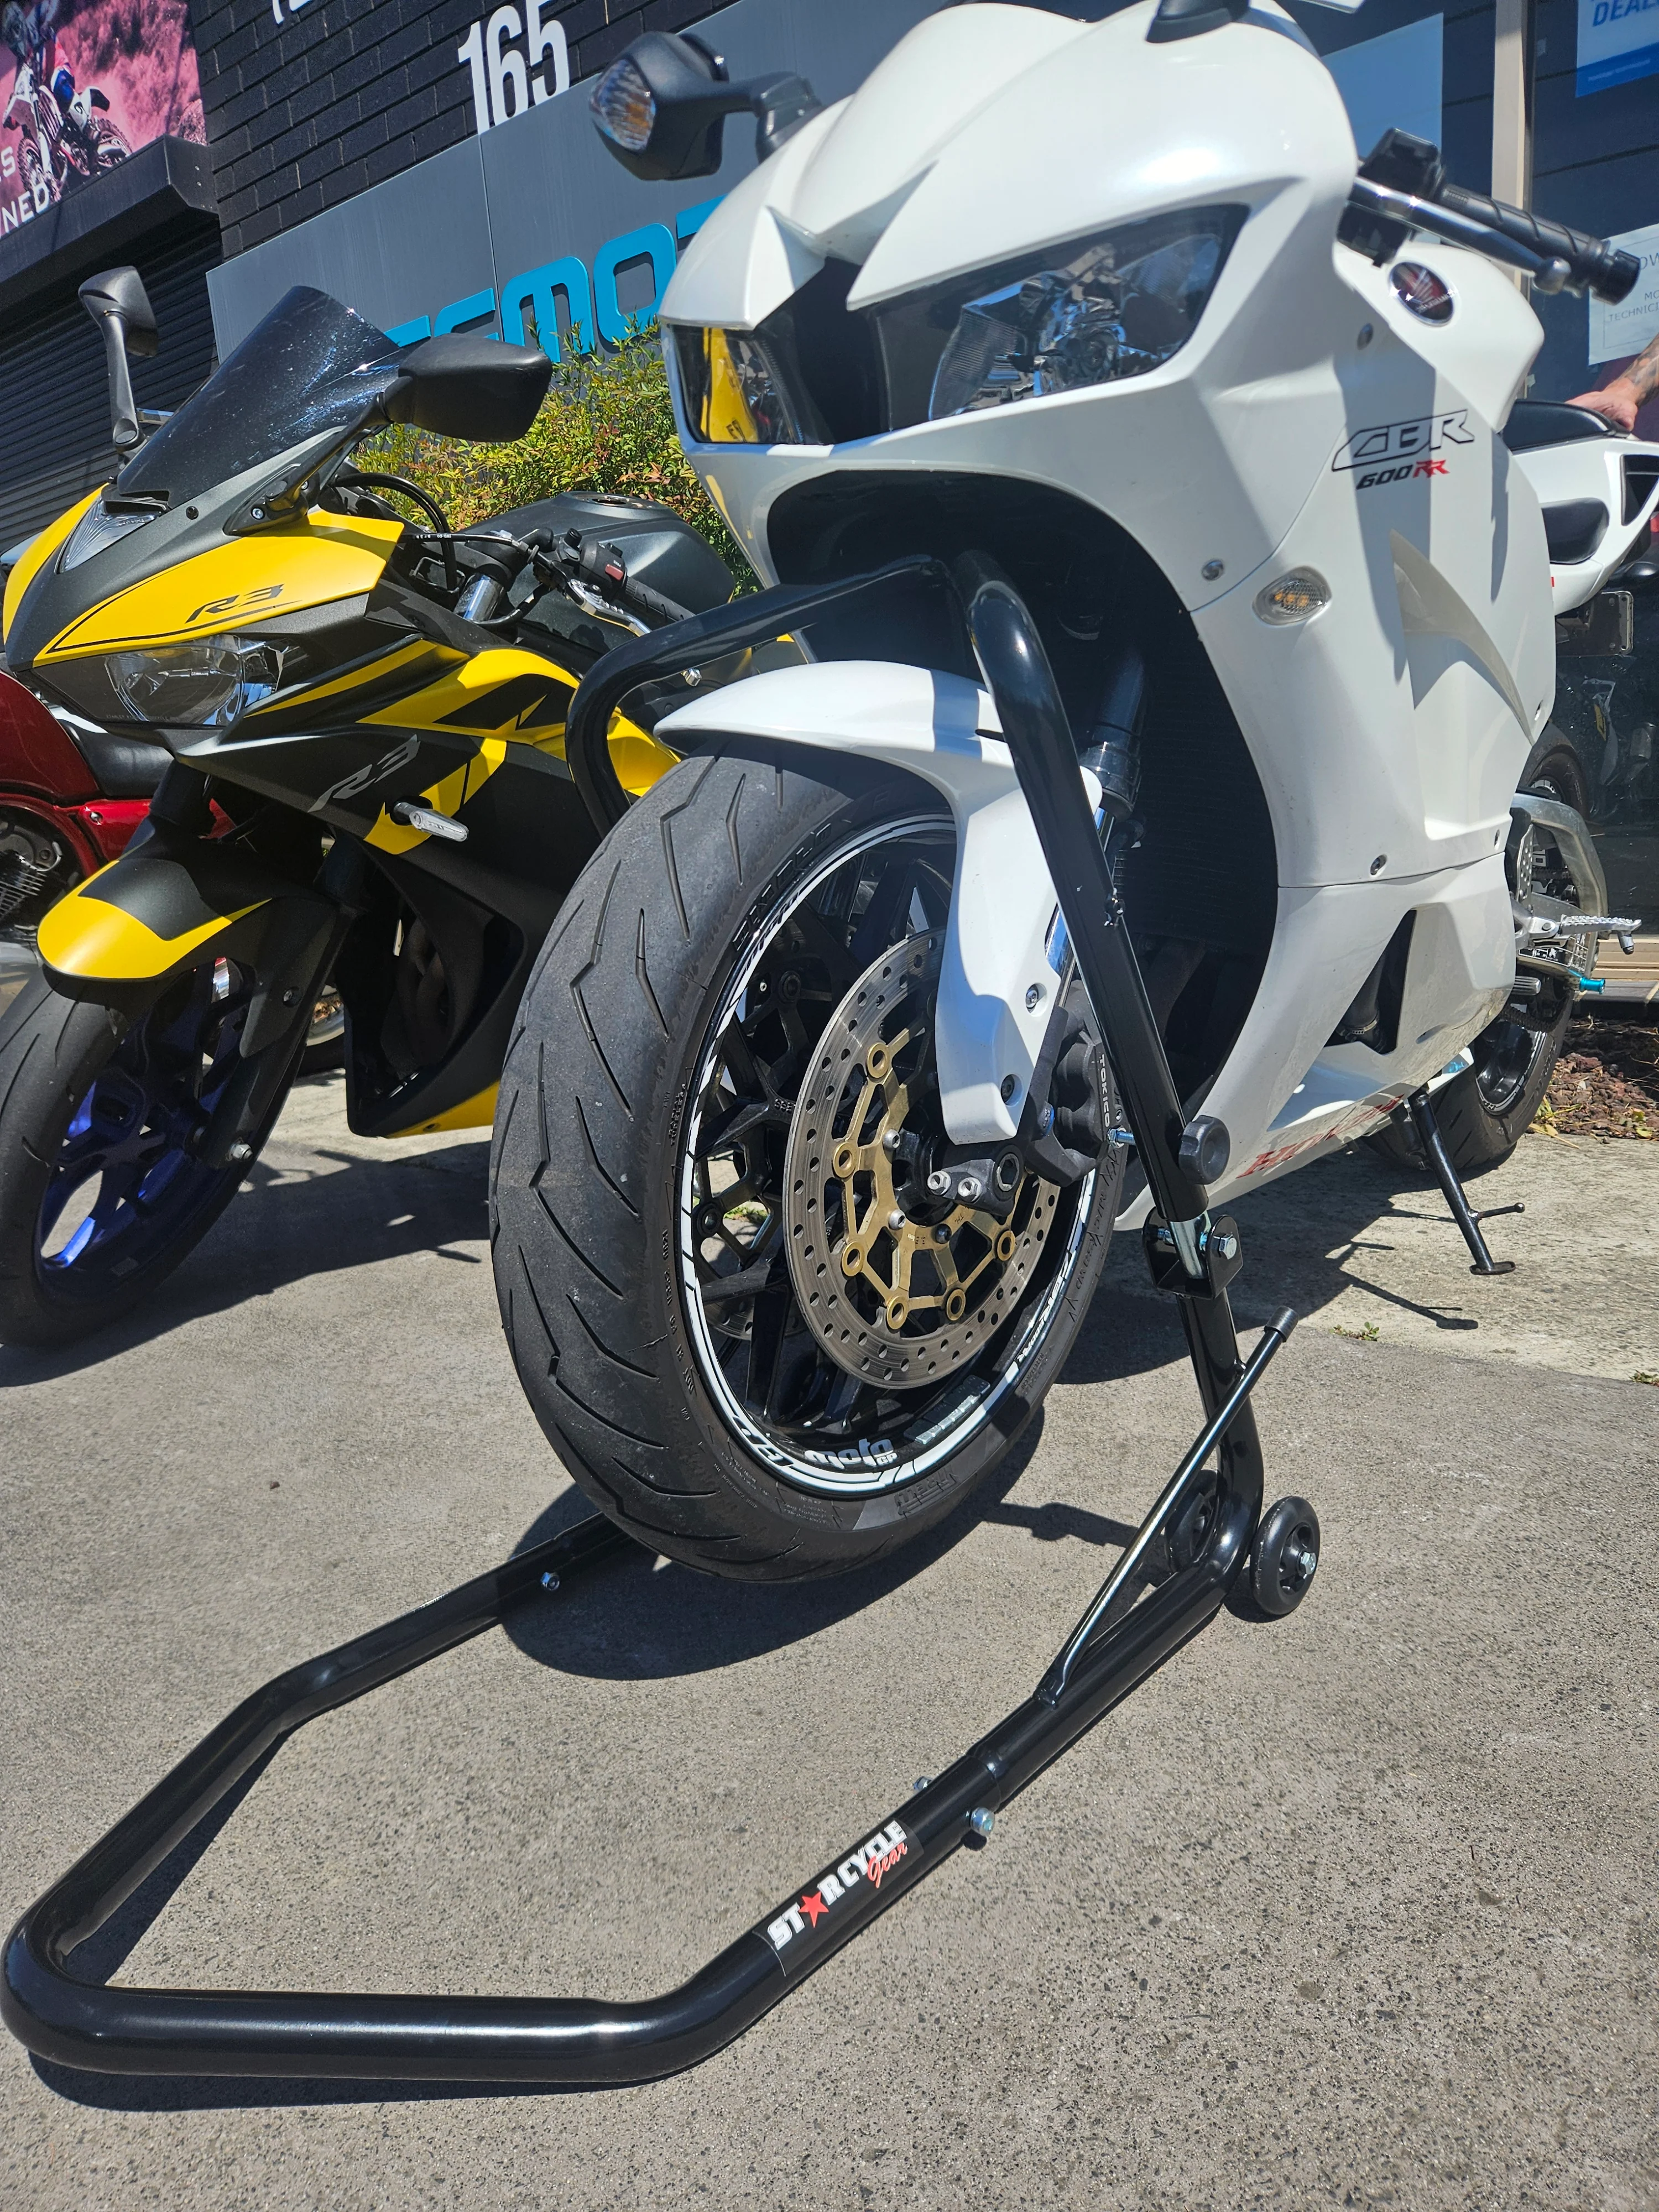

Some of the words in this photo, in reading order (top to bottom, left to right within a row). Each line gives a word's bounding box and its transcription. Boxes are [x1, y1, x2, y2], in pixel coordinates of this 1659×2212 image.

[458, 0, 570, 134] 165
[1332, 409, 1475, 472] CBR
[1356, 460, 1450, 490] 600RR
[185, 583, 284, 623] R3
[307, 734, 421, 813] R3
[1099, 1053, 1110, 1128] TOKICO
[804, 1438, 894, 1470] moto
